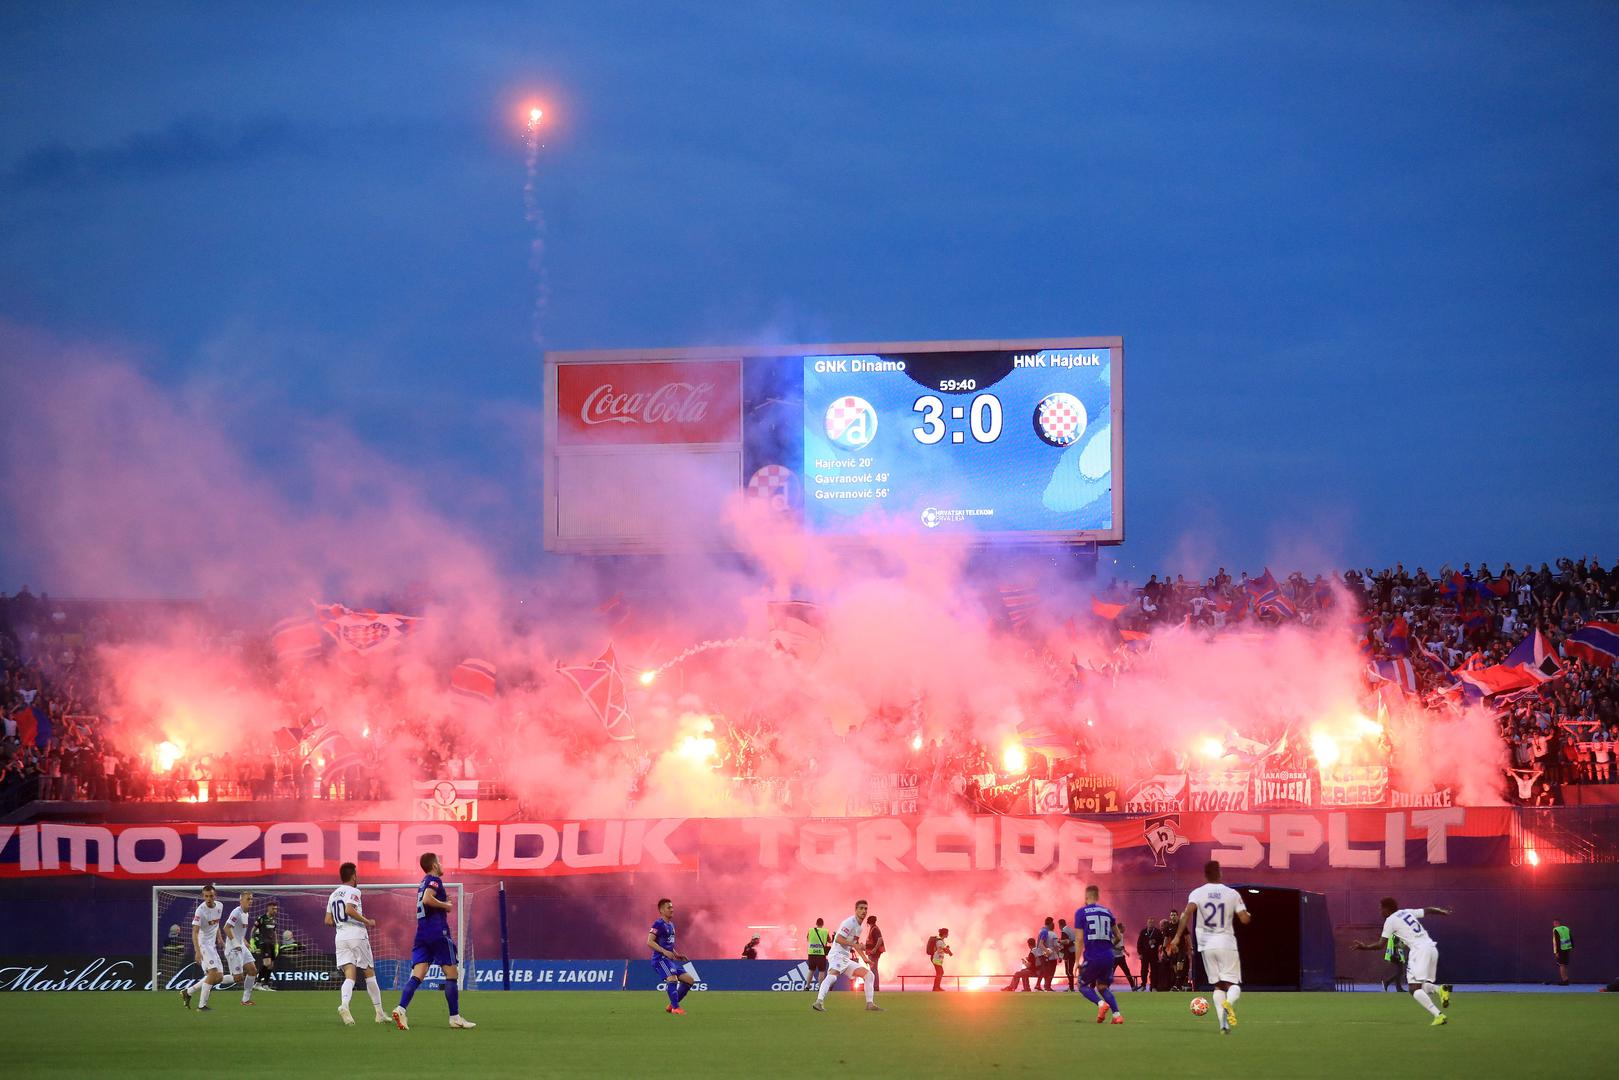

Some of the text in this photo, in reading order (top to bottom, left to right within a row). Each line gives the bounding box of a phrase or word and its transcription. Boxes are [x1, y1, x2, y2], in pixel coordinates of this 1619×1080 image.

[815, 360, 906, 372] GNK Dinamo
[1014, 354, 1100, 369] HNK Hajduk
[939, 379, 976, 391] 59:40
[912, 393, 1004, 445] 3:0
[815, 458, 856, 470] Hajrović
[815, 473, 872, 484] Gavranović
[815, 488, 872, 499] Gavranović
[1104, 791, 1119, 812] 1
[1191, 790, 1246, 811] TROGIR
[1254, 778, 1311, 807] RIVIJERA
[197, 822, 325, 873] ZA
[340, 818, 684, 870] HAJDUK
[742, 808, 1465, 875] TORCIDA SPLIT
[332, 900, 348, 922] 10
[1204, 902, 1225, 928] 21
[1086, 915, 1112, 940] 30
[1403, 914, 1421, 933] 5
[269, 972, 330, 981] ATERING
[537, 970, 553, 982] JE
[558, 970, 614, 983] ZAKON!
